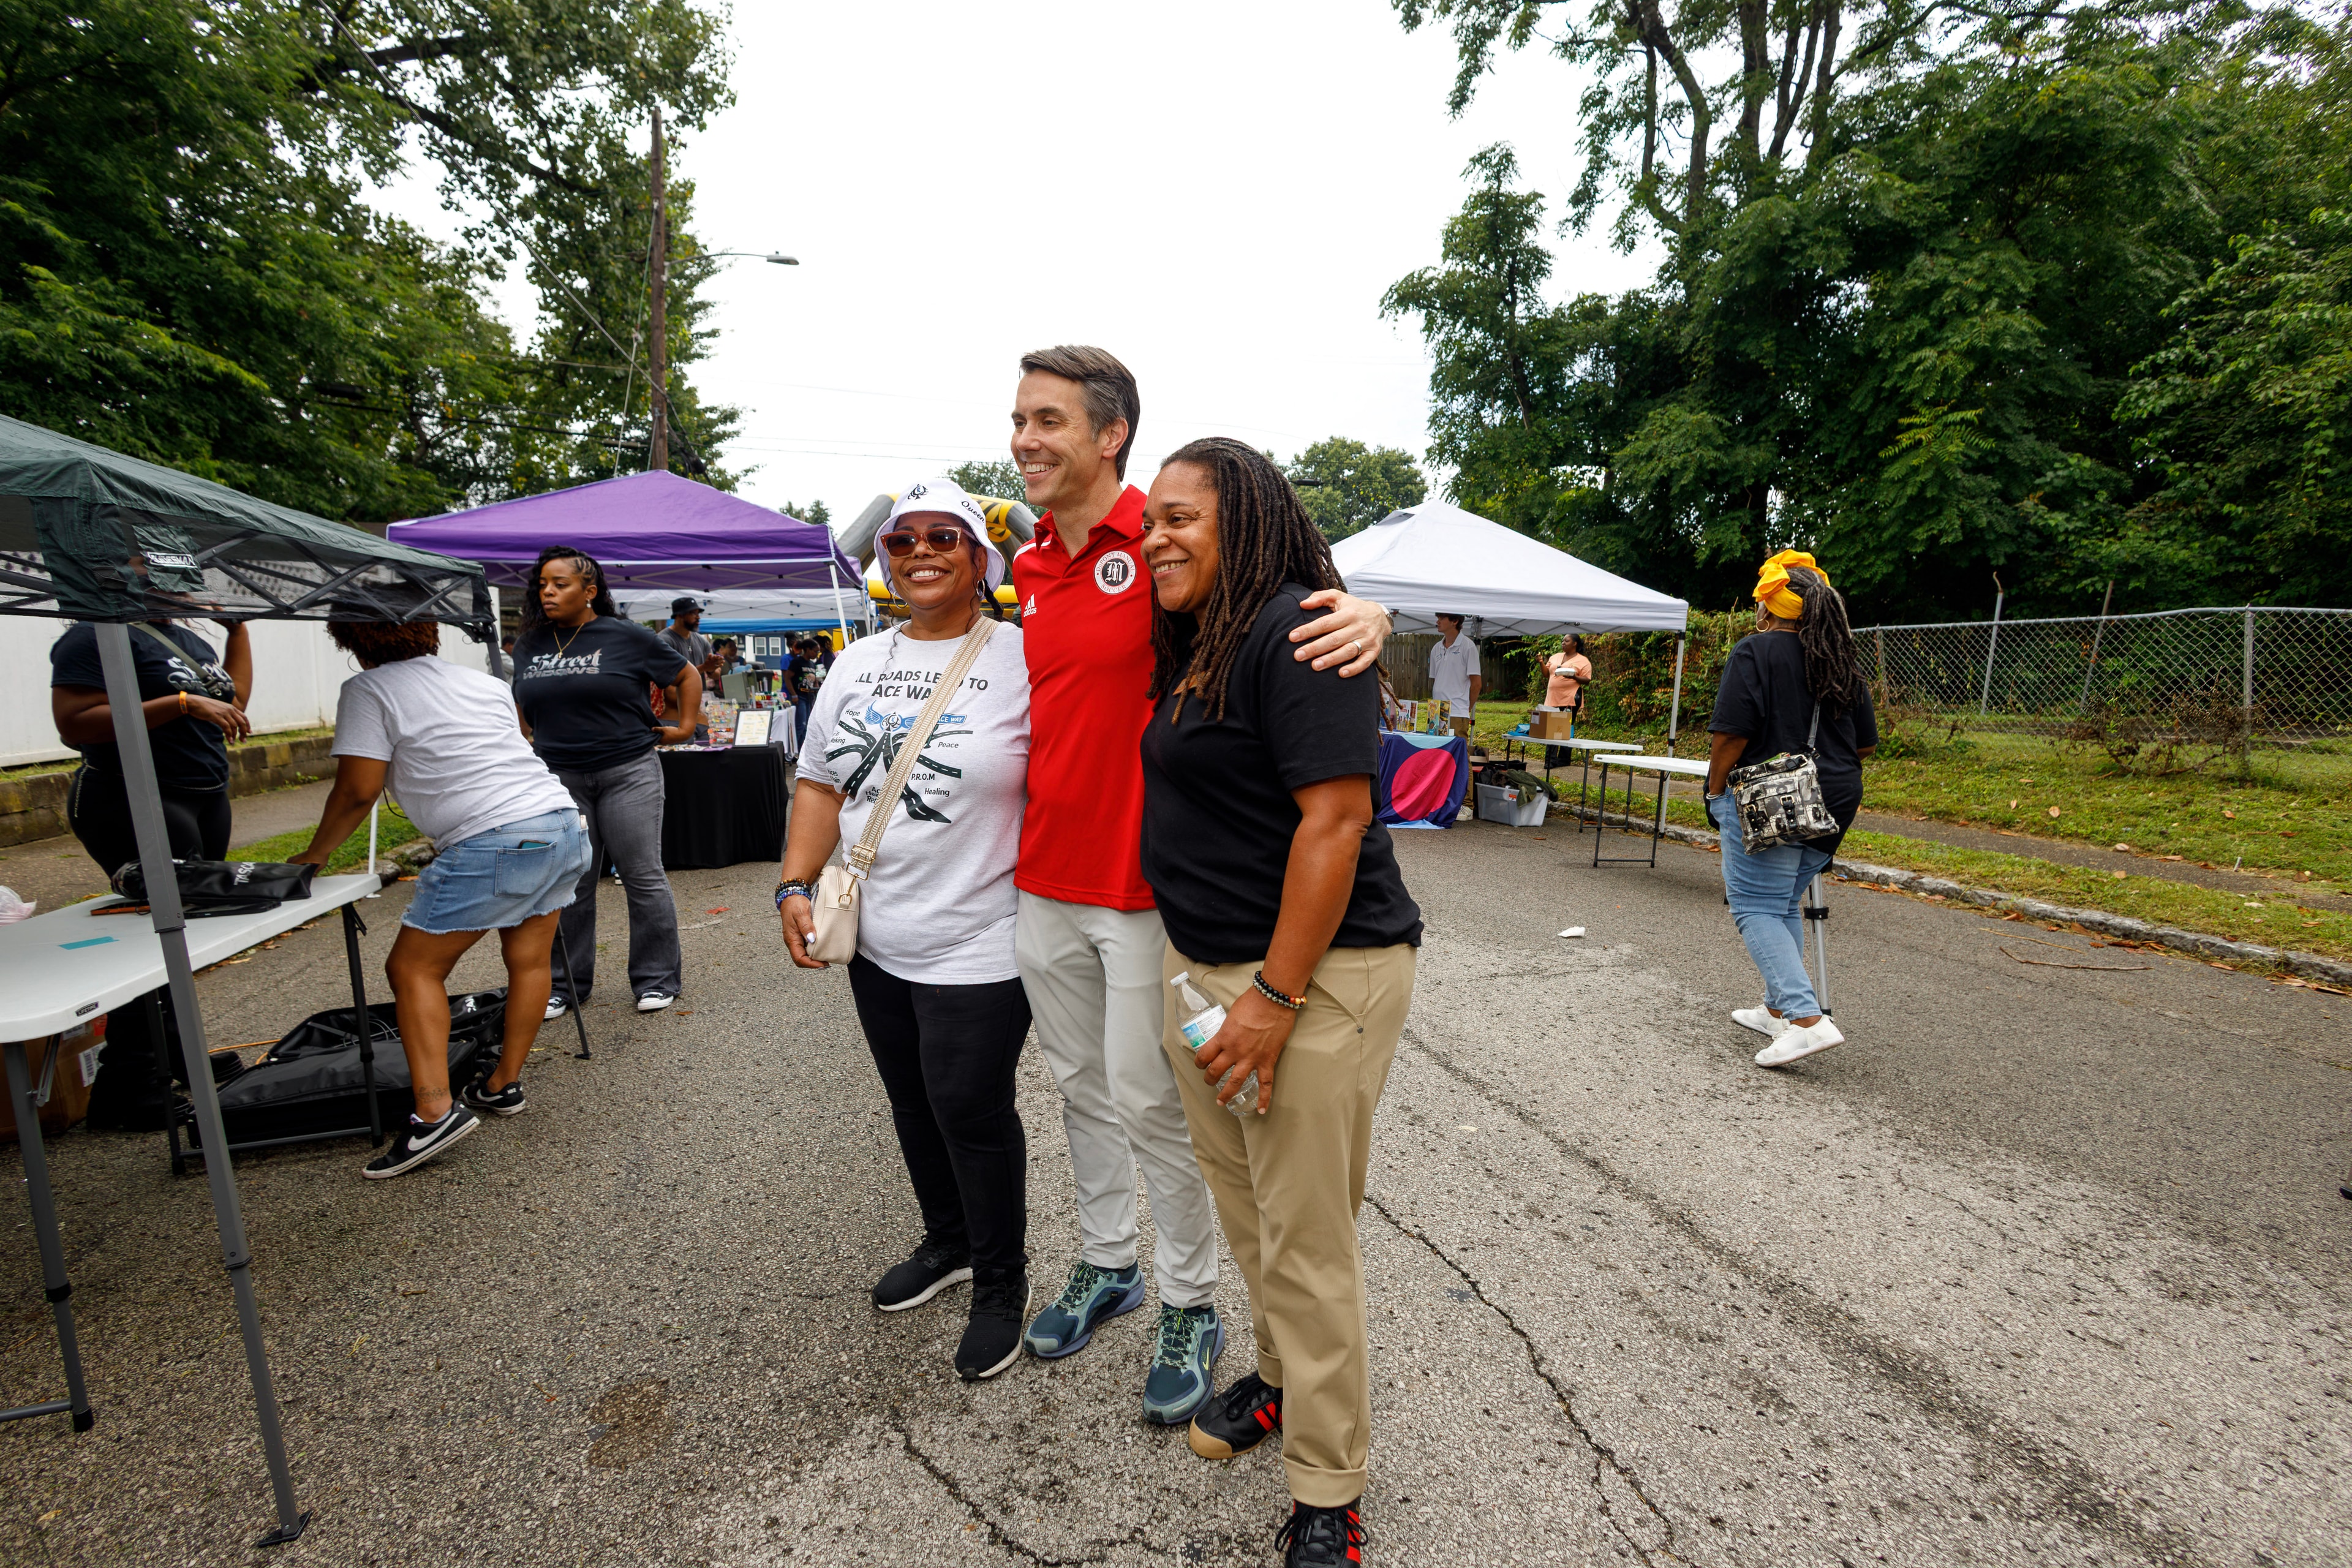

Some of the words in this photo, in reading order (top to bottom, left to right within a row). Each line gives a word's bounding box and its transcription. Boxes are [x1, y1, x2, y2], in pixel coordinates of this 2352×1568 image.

[960, 500, 985, 524] Queen
[1117, 552, 1135, 573] MANUAL
[1101, 584, 1126, 593] SOCCER
[1023, 607, 1037, 618] adidas
[524, 648, 602, 672] Street
[969, 677, 989, 691] TO
[871, 684, 903, 698] ACE
[907, 684, 932, 700] WA
[845, 708, 861, 717] Hope
[924, 787, 950, 797] Healing
